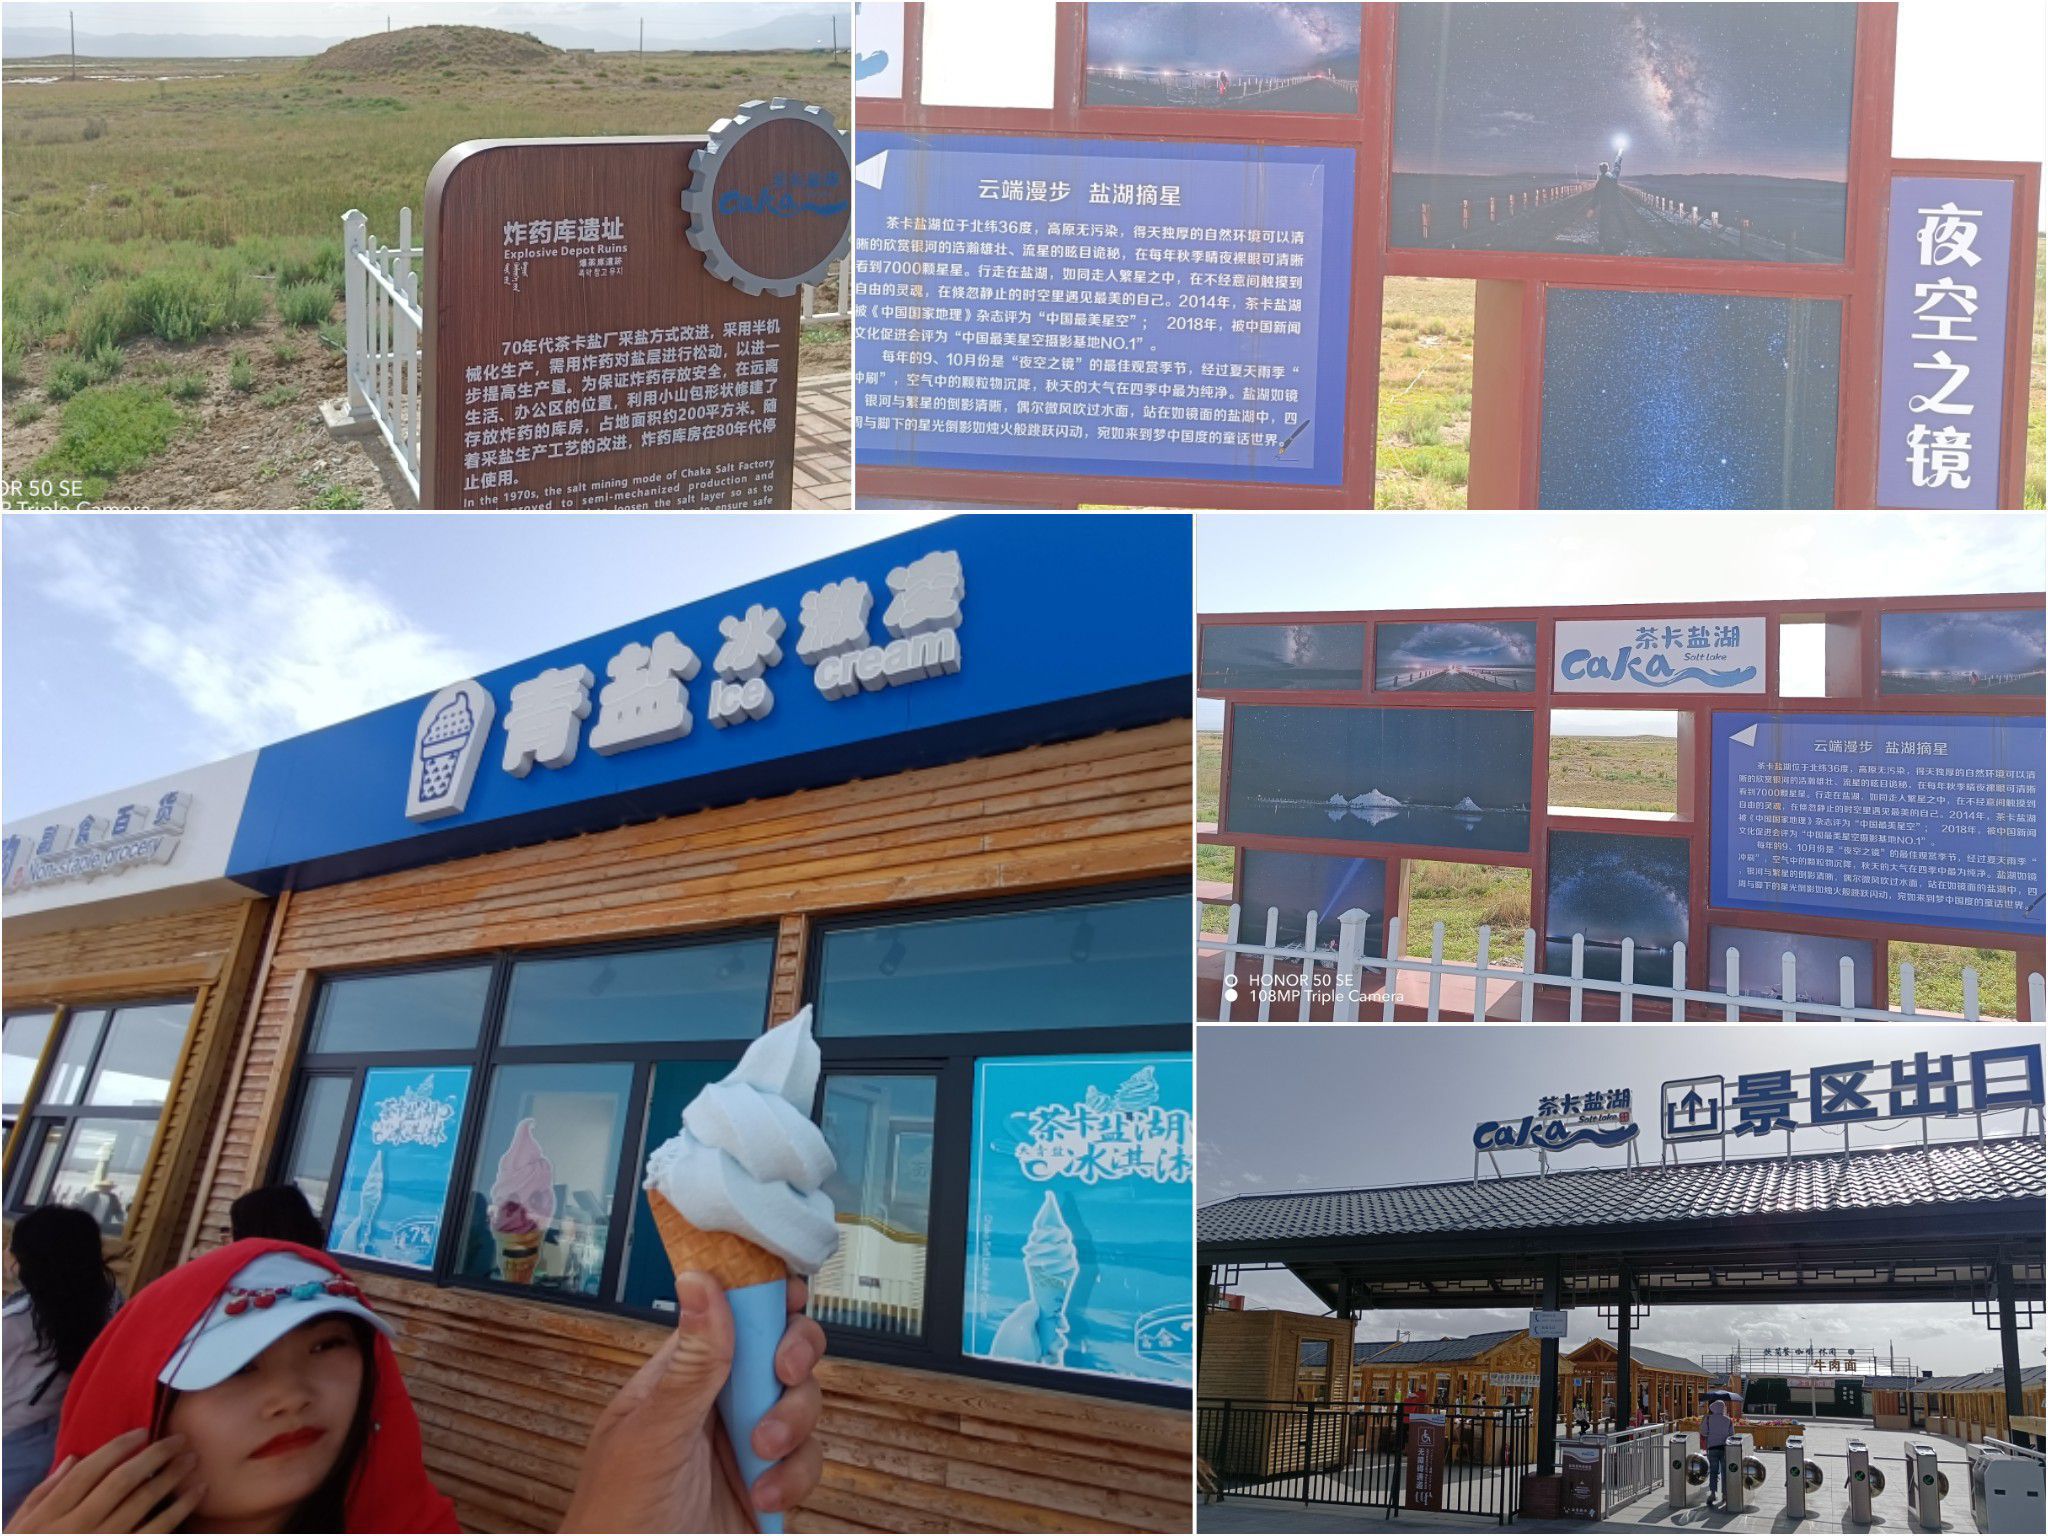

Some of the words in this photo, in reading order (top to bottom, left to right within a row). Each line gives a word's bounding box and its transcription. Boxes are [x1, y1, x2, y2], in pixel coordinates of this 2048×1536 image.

[978, 178, 1072, 203] 云端漫步
[1088, 182, 1182, 207] 盐湖摘星
[503, 216, 625, 246] 炸药库遗址
[504, 247, 558, 260] Explosive
[561, 245, 595, 258] Depot
[597, 243, 628, 254] Ruins
[502, 318, 780, 356] 70年代茶卡盐厂采盐方式改进，采用半机
[1166, 316, 1301, 335] 2018年，被中国新闻
[1905, 201, 1983, 490] 夜空之镜
[466, 339, 780, 383] 械化生产，需用炸药对盐层进行松动，以进一
[465, 358, 779, 405] 步提高生产量。为保证炸药存放安全，在远离
[465, 378, 778, 426] 生活、办公区的位置，利用小山包形状修建了
[464, 418, 777, 470] 着采盐生产工艺的改进，炸药库房在80年代停
[463, 469, 519, 491] 止使用。
[464, 498, 475, 508] In
[480, 495, 498, 506] the
[503, 489, 539, 502] 1970s,
[544, 486, 562, 498] the
[566, 482, 586, 494] salt
[591, 476, 628, 490] mining
[633, 472, 661, 485] mode
[666, 470, 677, 480] of
[681, 467, 711, 479] Chaka
[715, 462, 735, 474] Salt
[738, 458, 775, 471] Factory
[561, 499, 573, 508] to
[582, 483, 681, 505] semi-mechanized
[688, 475, 748, 492] production
[755, 470, 774, 481] and
[654, 499, 671, 508] the
[677, 494, 696, 505] salt
[700, 492, 726, 503] layer
[731, 490, 742, 498] so
[747, 487, 758, 495] as
[763, 484, 774, 493] to
[752, 496, 774, 506] safe
[1635, 625, 1740, 650] 茶卡盐湖
[502, 549, 965, 777] 青盐冰激凌
[1684, 652, 1705, 661] Salt
[708, 677, 773, 727] Ice
[814, 627, 961, 701] cream
[1813, 739, 1875, 754] 云端漫步
[1885, 740, 1949, 756] 盐湖摘星
[1538, 1088, 1631, 1117] 茶卡盐湖
[1731, 1044, 2044, 1136] 景区出口
[1033, 1105, 1187, 1146] 茶卡盐湖
[1578, 1114, 1597, 1123] Salt
[1814, 1359, 1857, 1372] 牛肉面
